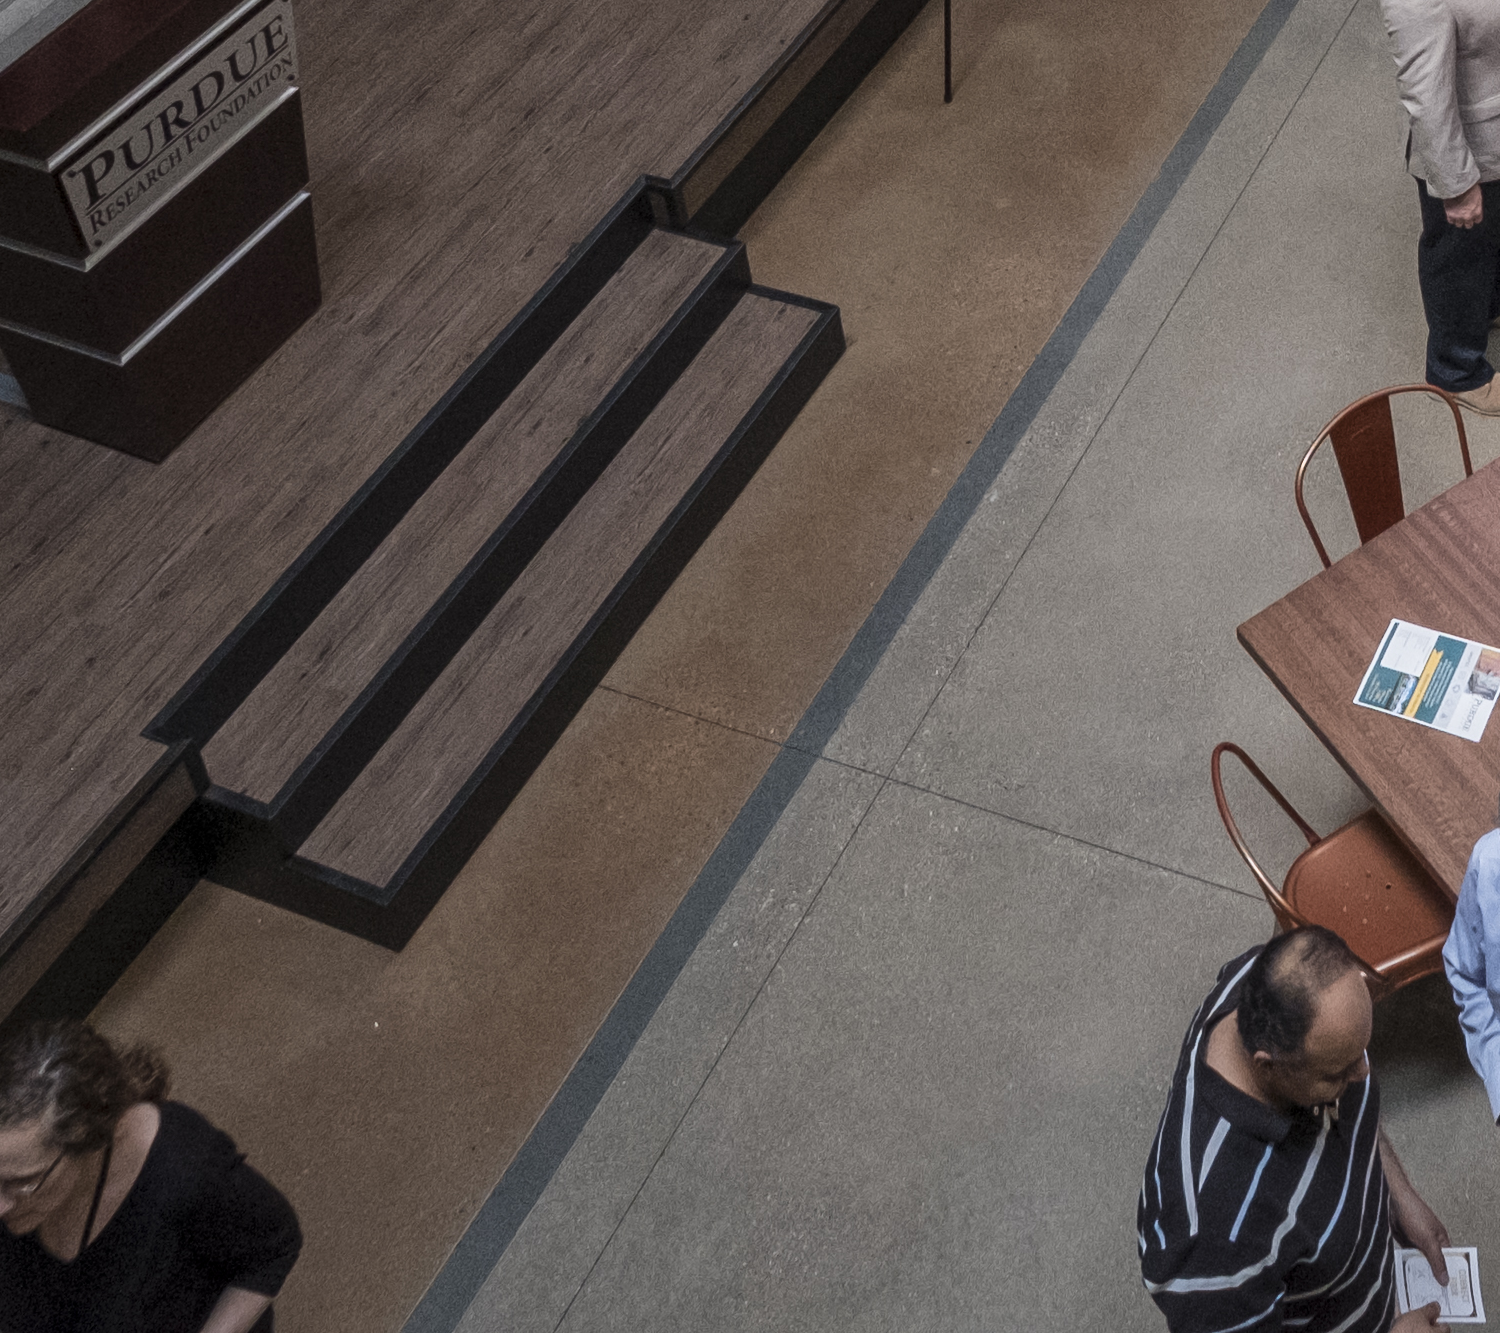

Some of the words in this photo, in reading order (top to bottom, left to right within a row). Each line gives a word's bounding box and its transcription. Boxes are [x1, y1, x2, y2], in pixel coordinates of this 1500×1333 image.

[74, 15, 289, 206] PURDUE
[89, 149, 183, 234] RESEARCH
[185, 53, 294, 155] FOUNDATION
